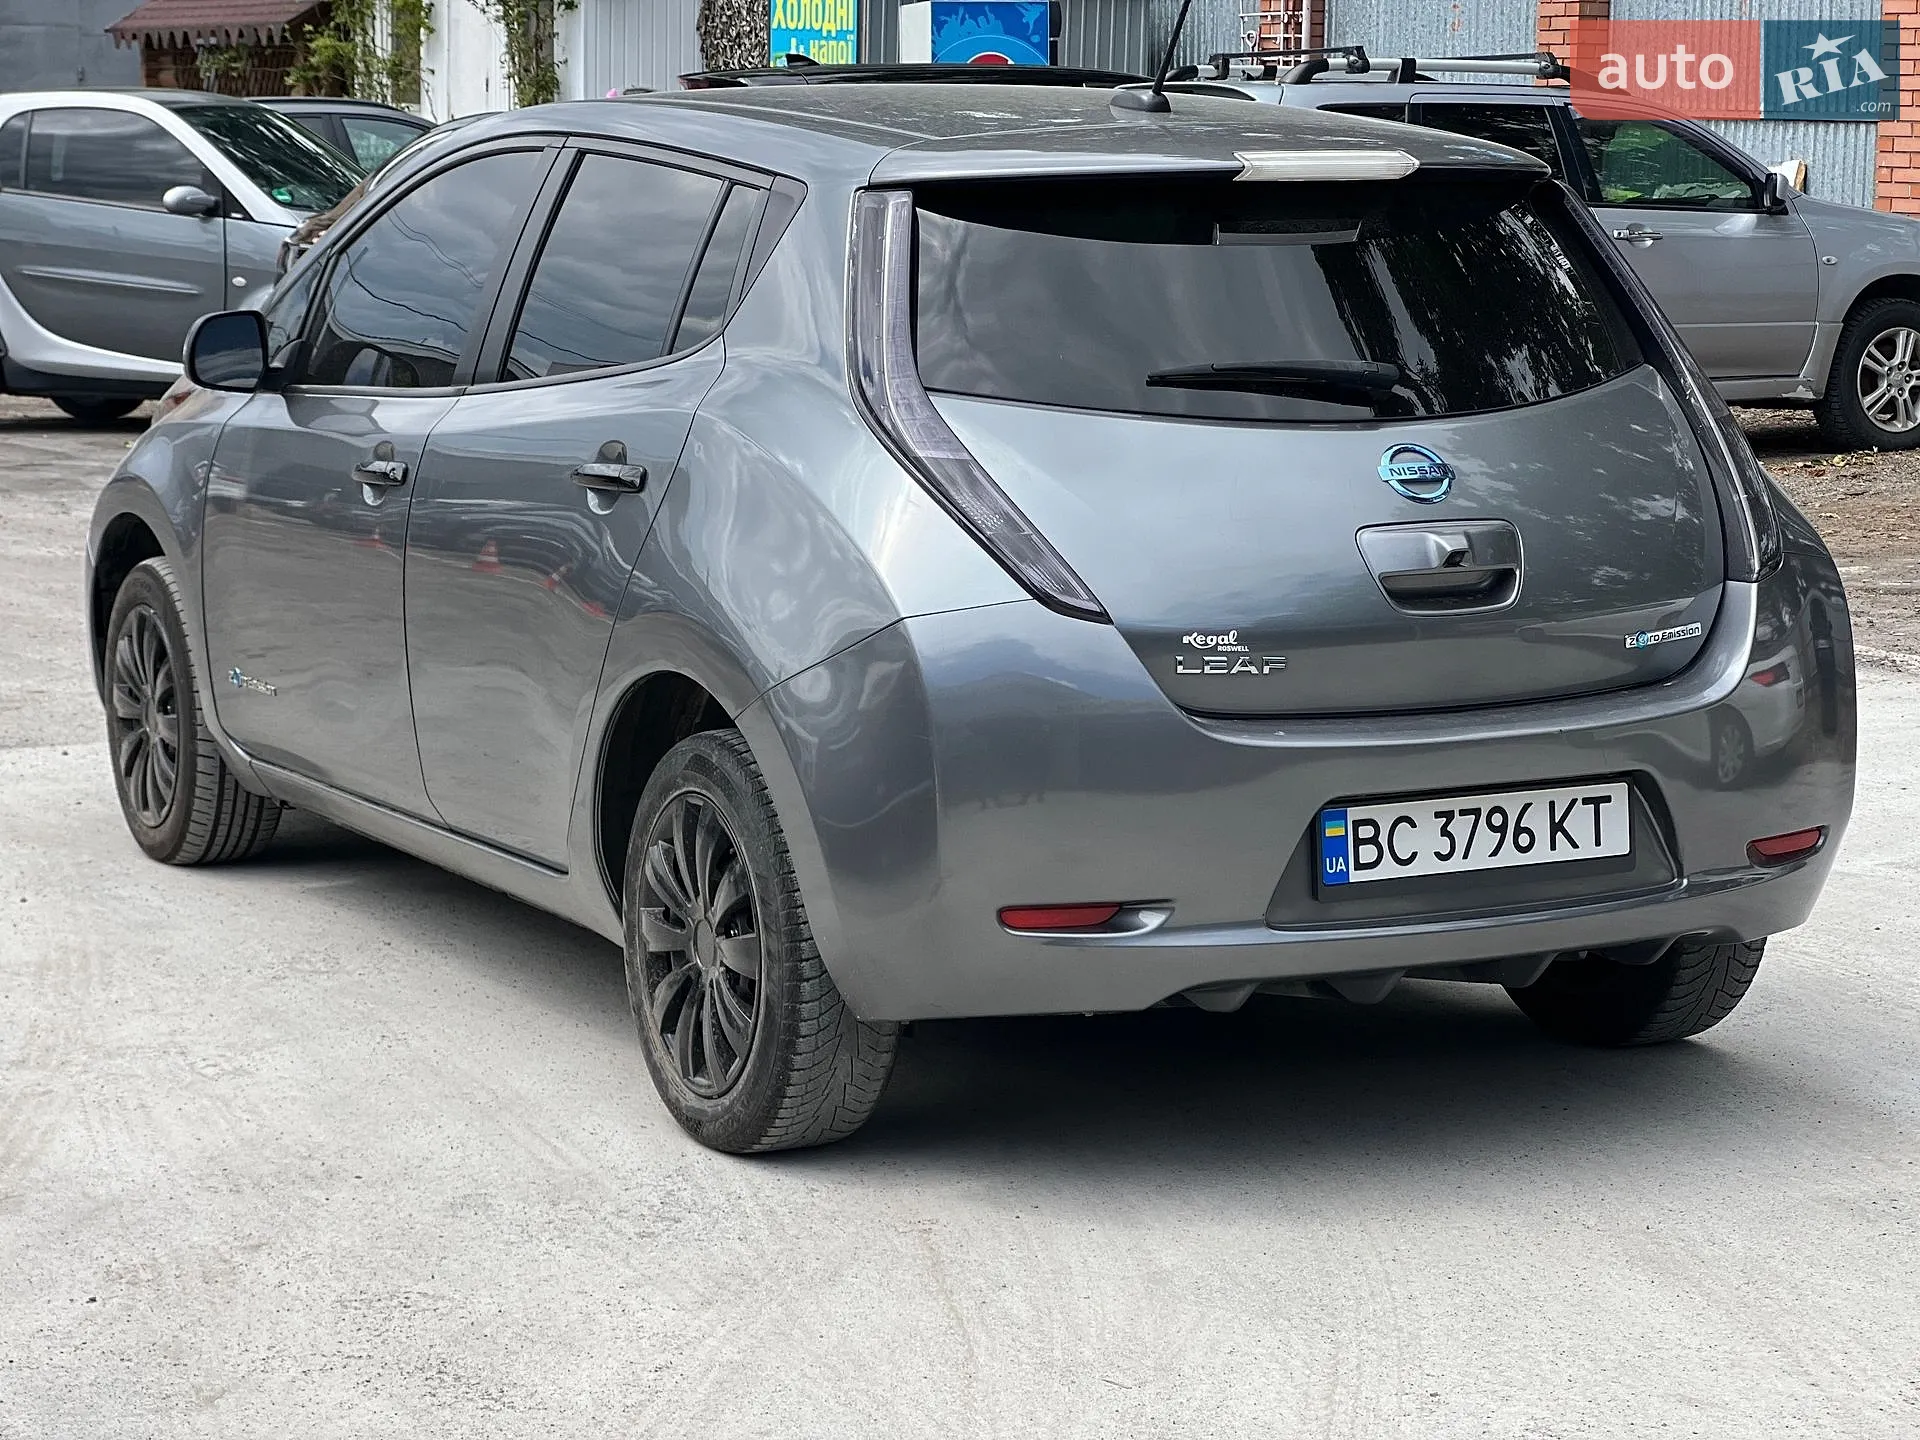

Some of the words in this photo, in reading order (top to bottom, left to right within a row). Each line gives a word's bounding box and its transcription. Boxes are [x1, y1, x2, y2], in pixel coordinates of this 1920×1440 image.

[809, 34, 854, 64] напої
[1389, 465, 1453, 477] NISSAN
[1661, 626, 1700, 640] Emission
[1175, 656, 1286, 674] LEAF
[1326, 856, 1346, 874] UA
[1351, 815, 1418, 871] BC
[1433, 802, 1536, 862] 3796
[1548, 795, 1612, 852] KT
